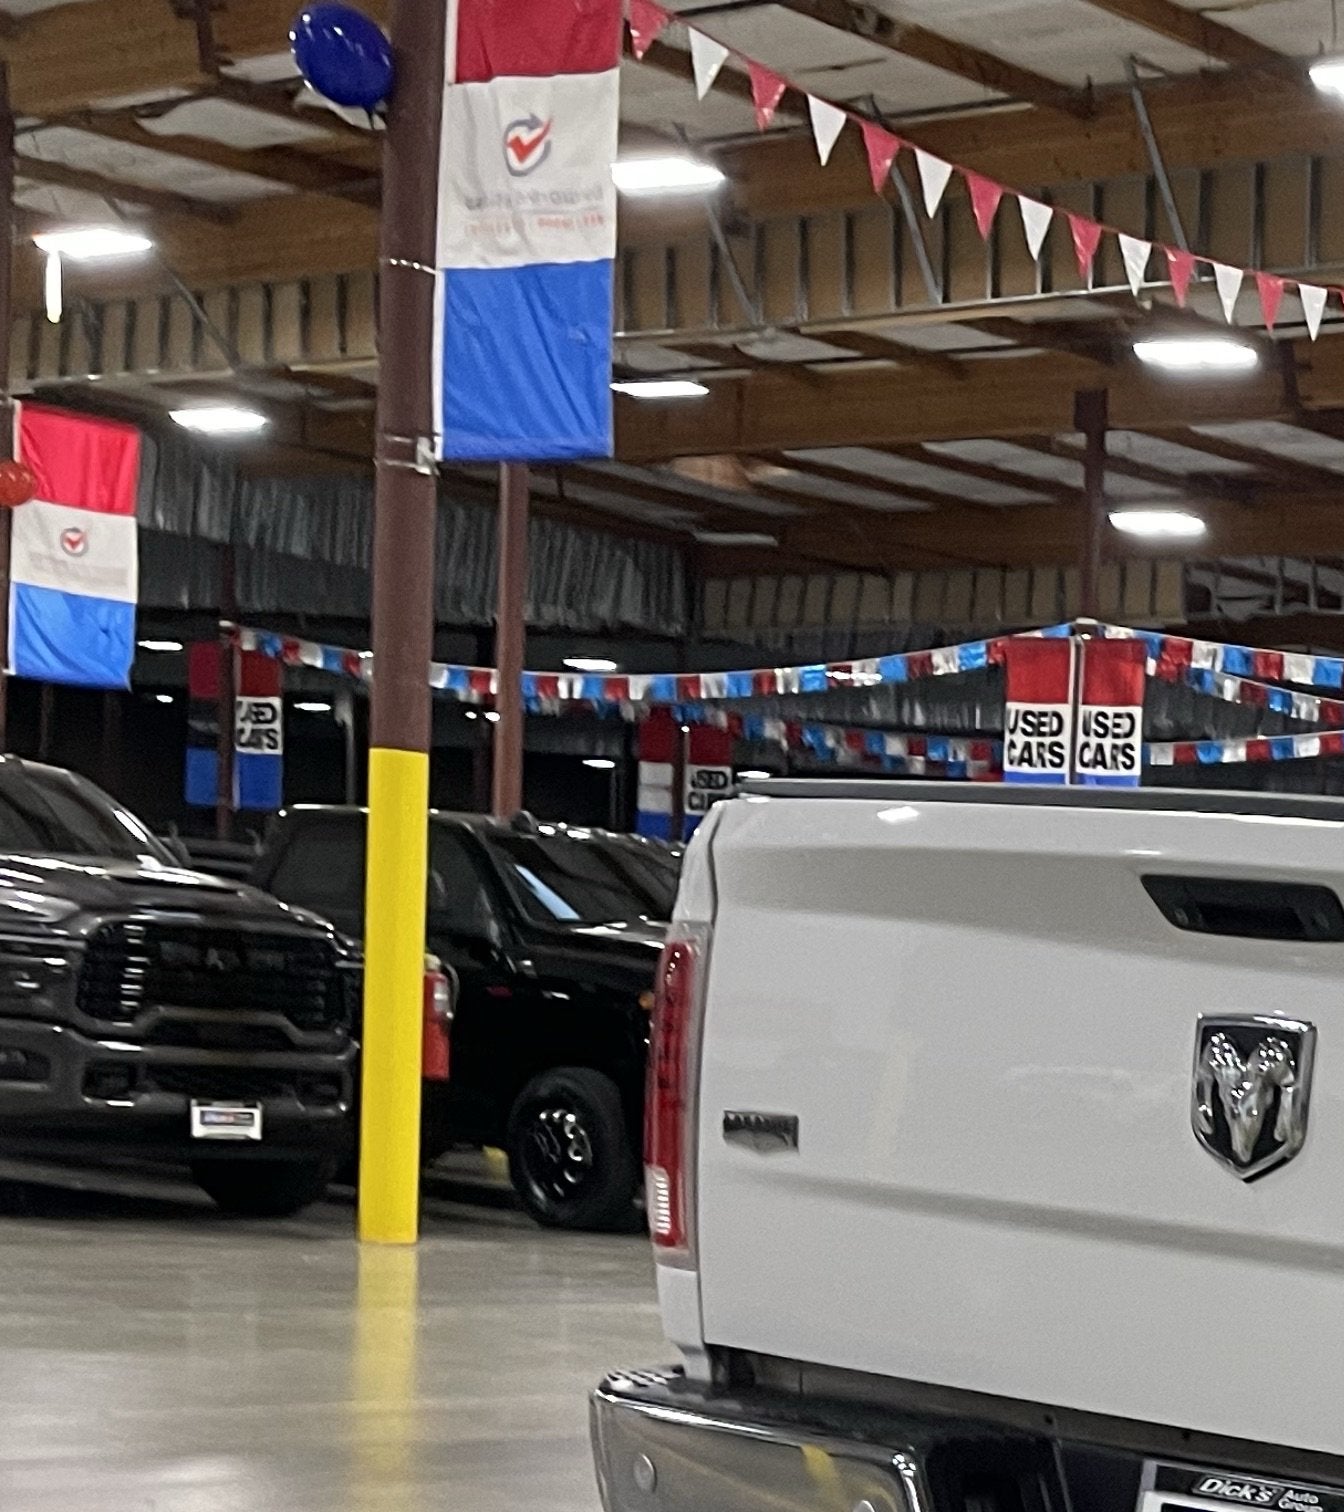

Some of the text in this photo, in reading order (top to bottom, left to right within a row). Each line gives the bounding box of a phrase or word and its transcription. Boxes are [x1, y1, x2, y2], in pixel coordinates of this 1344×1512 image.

[1007, 708, 1064, 738] USED
[1082, 710, 1136, 739] USED
[1007, 738, 1065, 769] CARS
[1079, 741, 1136, 771] CARS
[1199, 1478, 1273, 1502] Dick's
[1285, 1489, 1320, 1504] Auto
